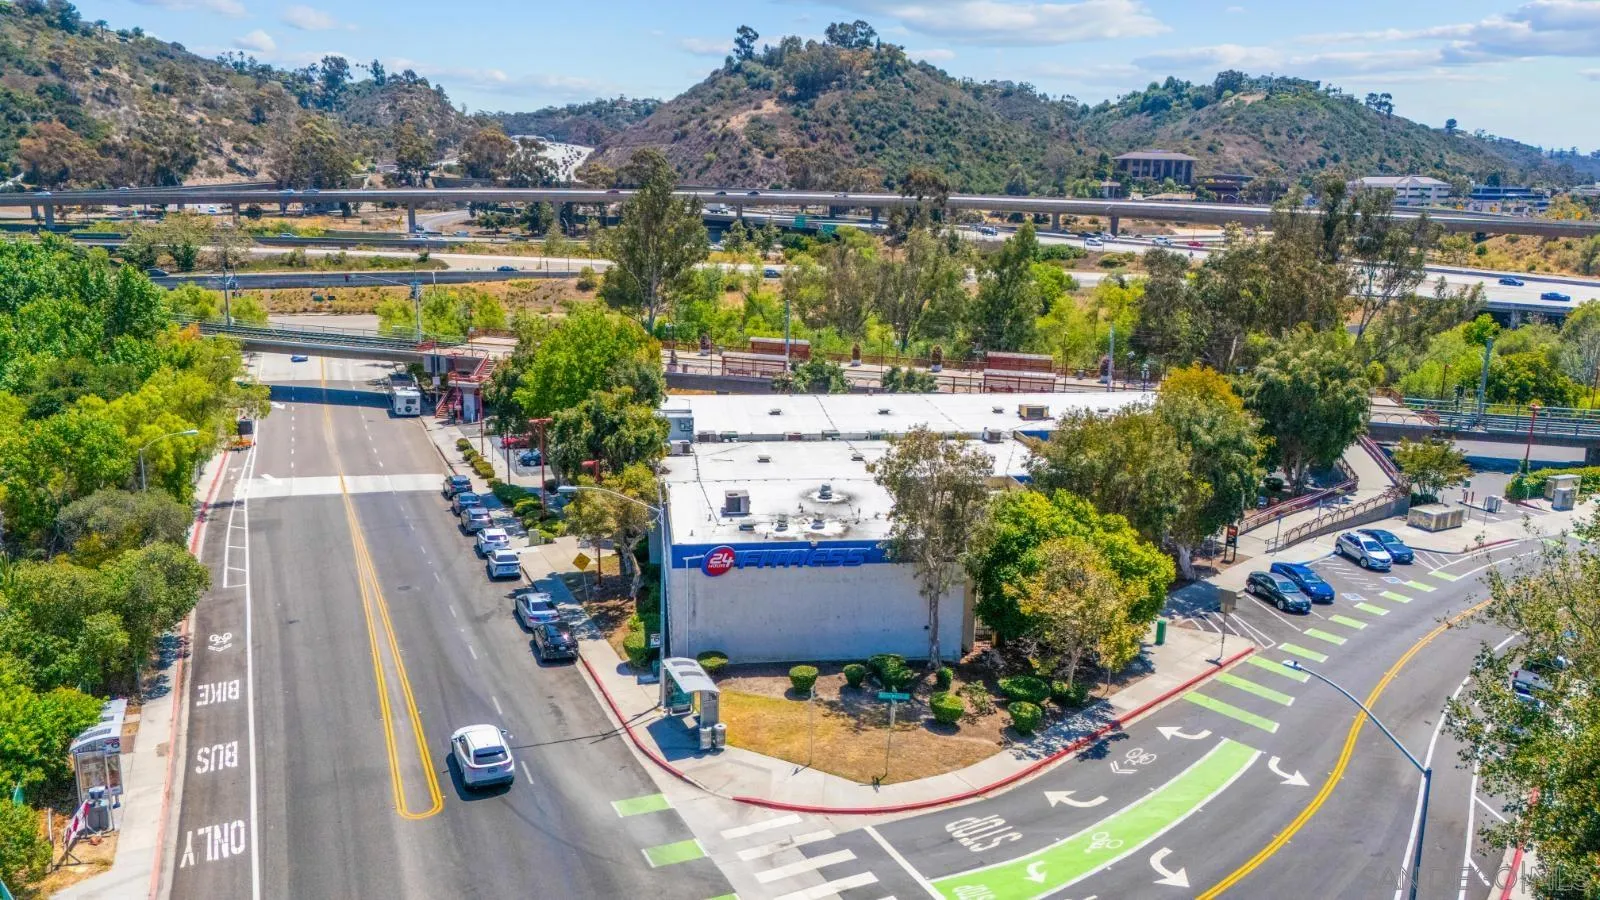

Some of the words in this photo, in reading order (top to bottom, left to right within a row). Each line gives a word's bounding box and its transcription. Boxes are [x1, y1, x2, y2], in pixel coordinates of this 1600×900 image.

[709, 552, 734, 568] 24
[737, 548, 868, 569] FITNESS
[196, 680, 240, 706] BIKE
[195, 741, 239, 774] BUS
[180, 819, 246, 868] ONLY
[945, 814, 1023, 852] STOP
